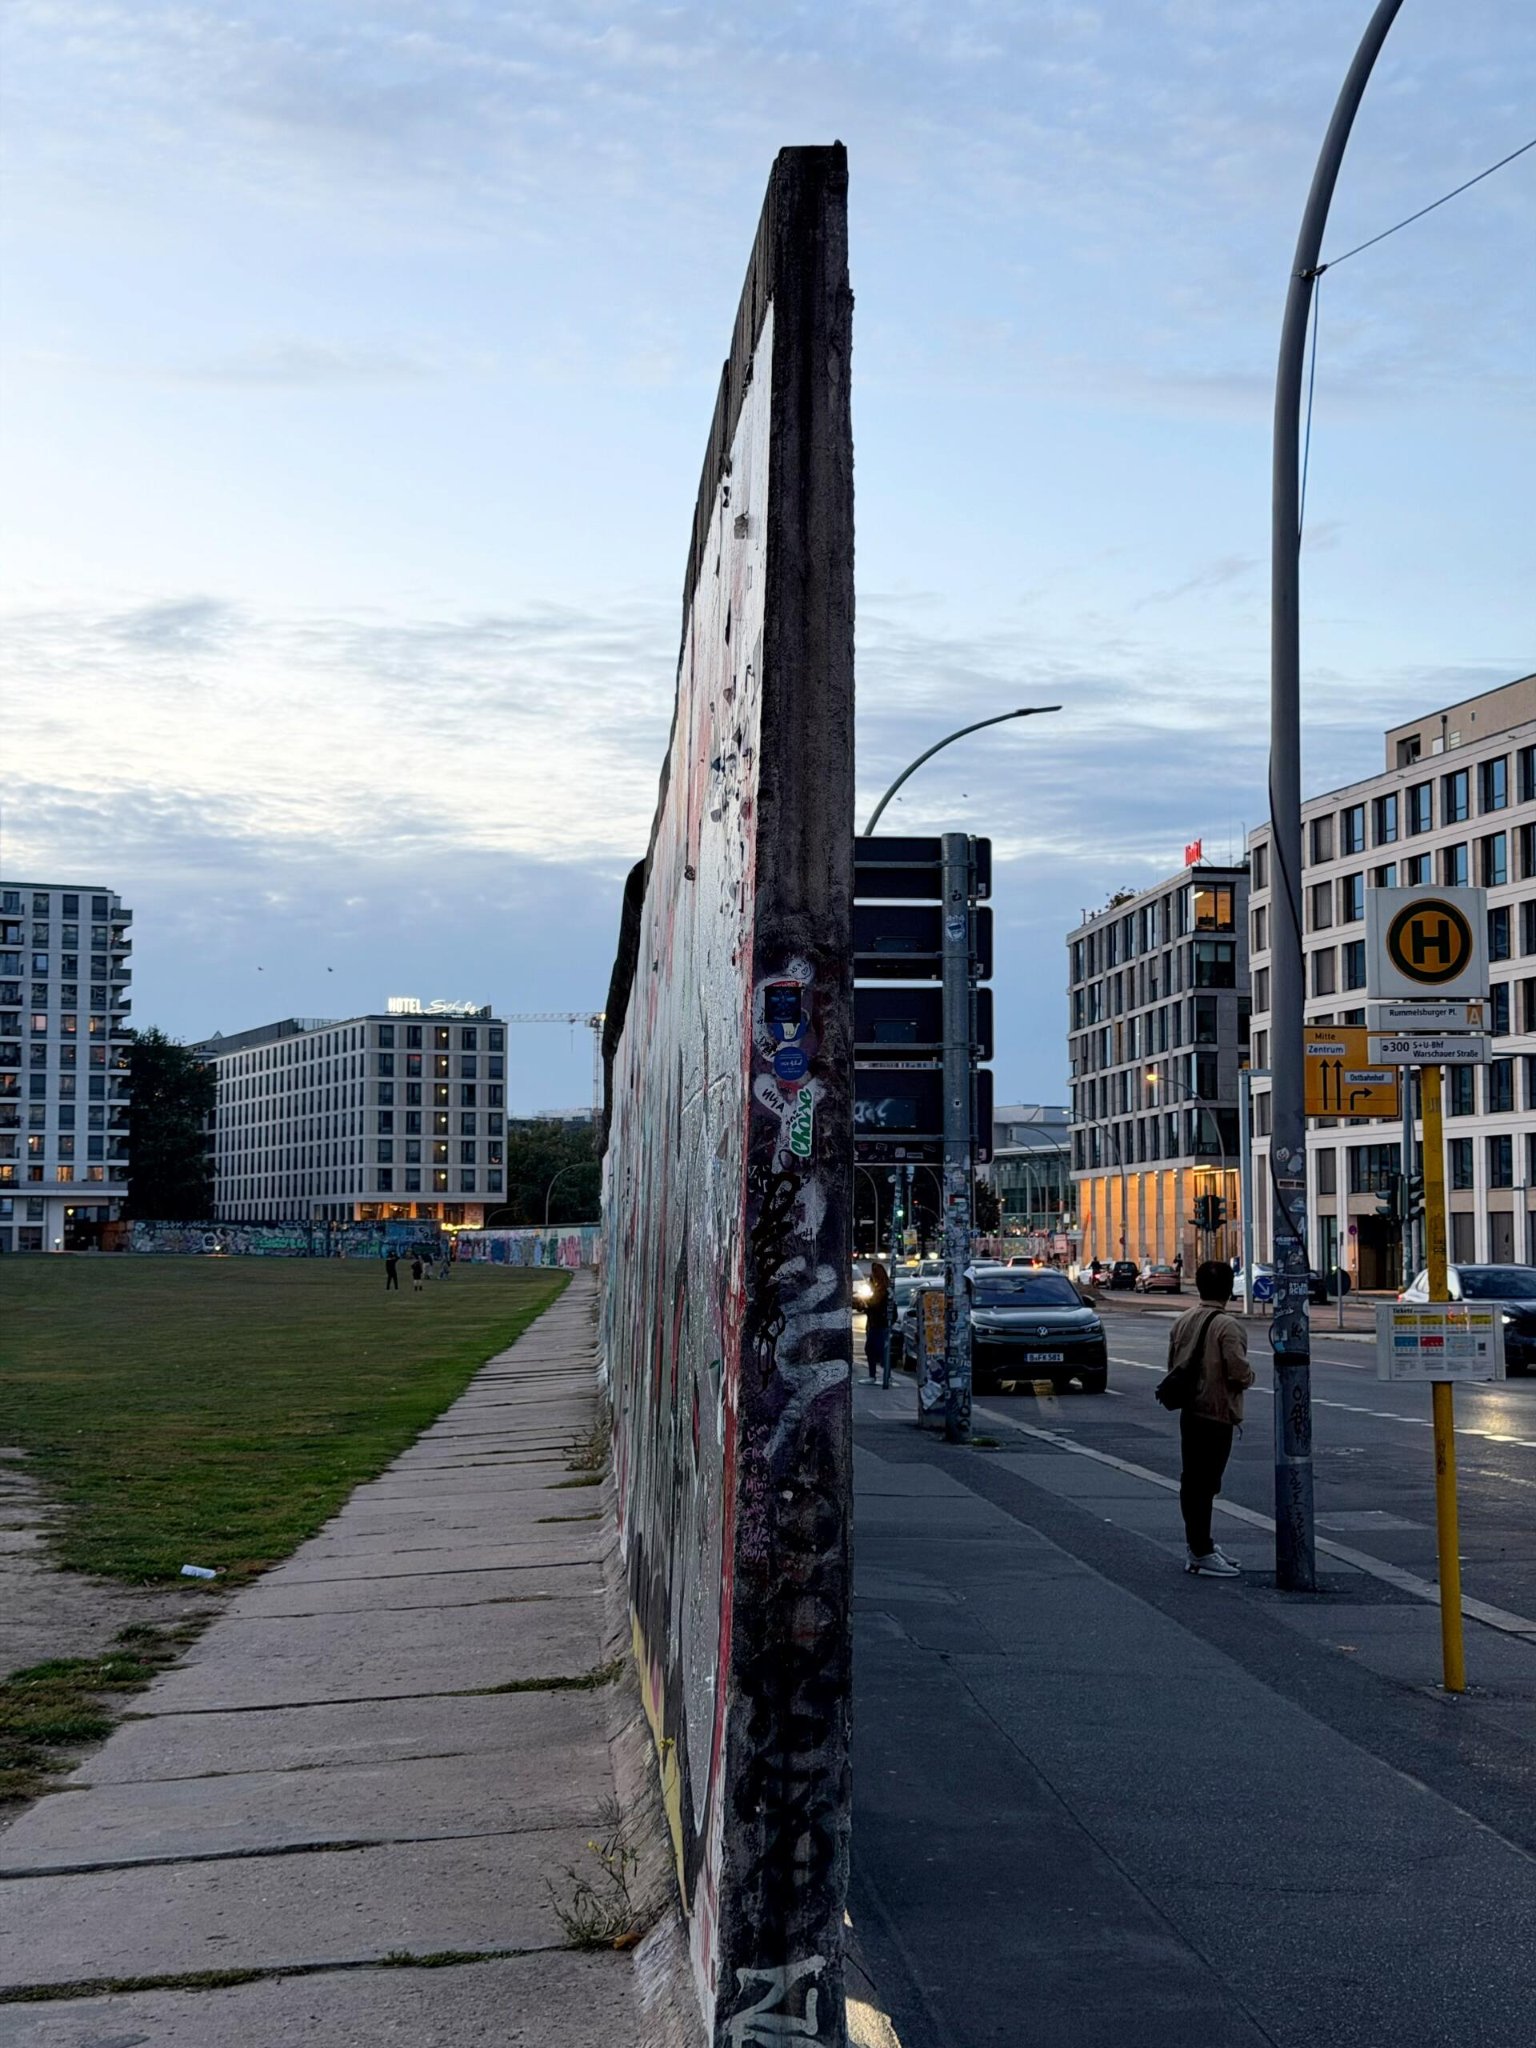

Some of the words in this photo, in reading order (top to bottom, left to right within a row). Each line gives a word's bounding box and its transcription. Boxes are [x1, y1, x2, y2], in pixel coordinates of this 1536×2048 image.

[1411, 920, 1451, 964] H
[388, 997, 421, 1013] HOTEL
[1389, 1007, 1447, 1018] Rummelsburger
[1448, 1007, 1457, 1016] Pl.
[1315, 1032, 1336, 1041] Mitte
[1308, 1045, 1344, 1054] Zentrum
[1390, 1042, 1410, 1052] 300
[1413, 1049, 1456, 1058] Warschauer
[1457, 1049, 1479, 1058] Straße
[1350, 1074, 1384, 1082] Ostbahnhof
